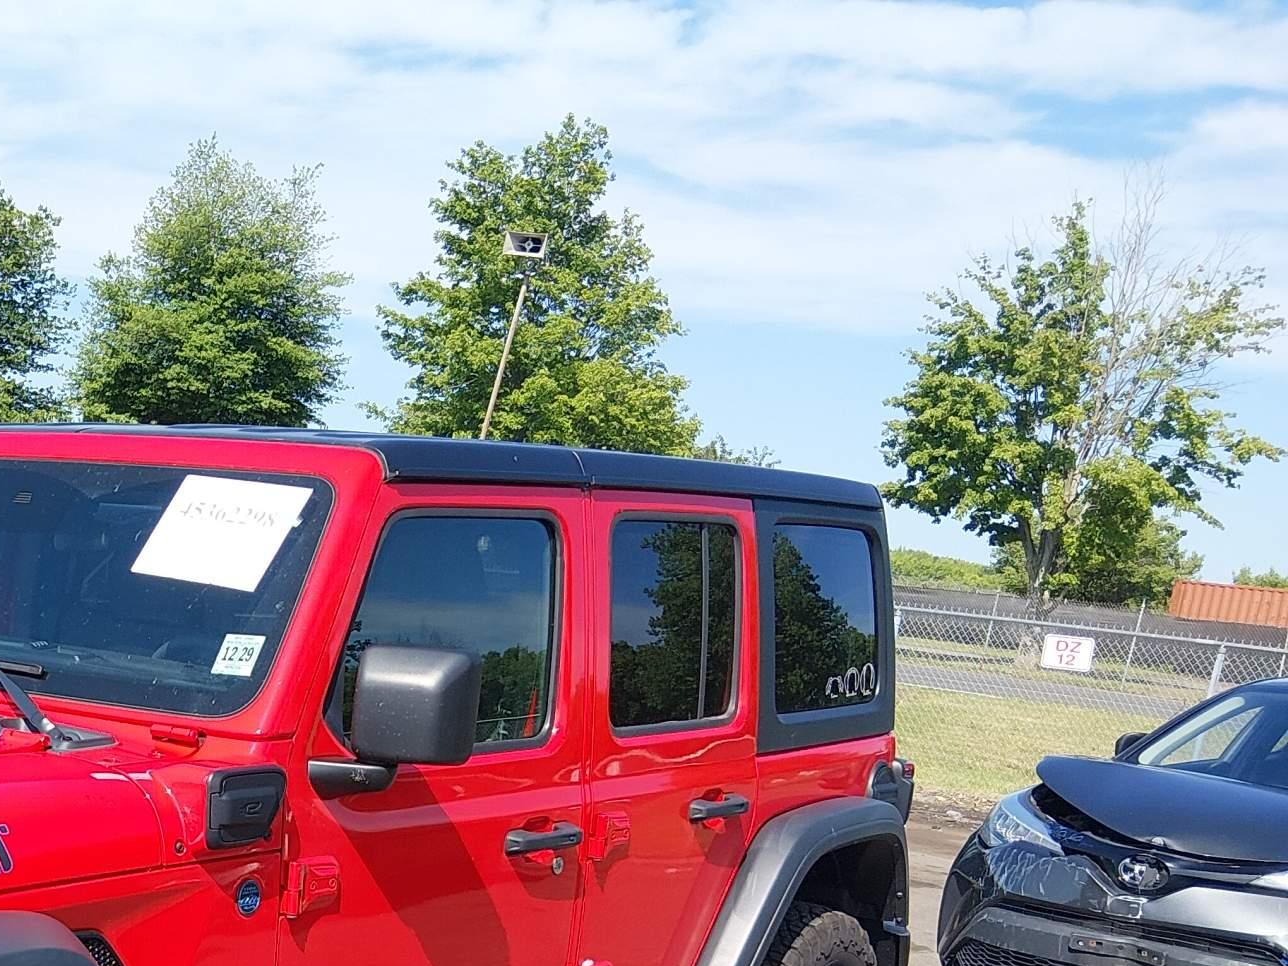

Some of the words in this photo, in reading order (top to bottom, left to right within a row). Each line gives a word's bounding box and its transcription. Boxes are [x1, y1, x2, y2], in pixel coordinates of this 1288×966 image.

[1056, 640, 1082, 653] DZ
[221, 646, 238, 661] 12
[238, 646, 255, 662] 29
[1057, 654, 1076, 666] 12
